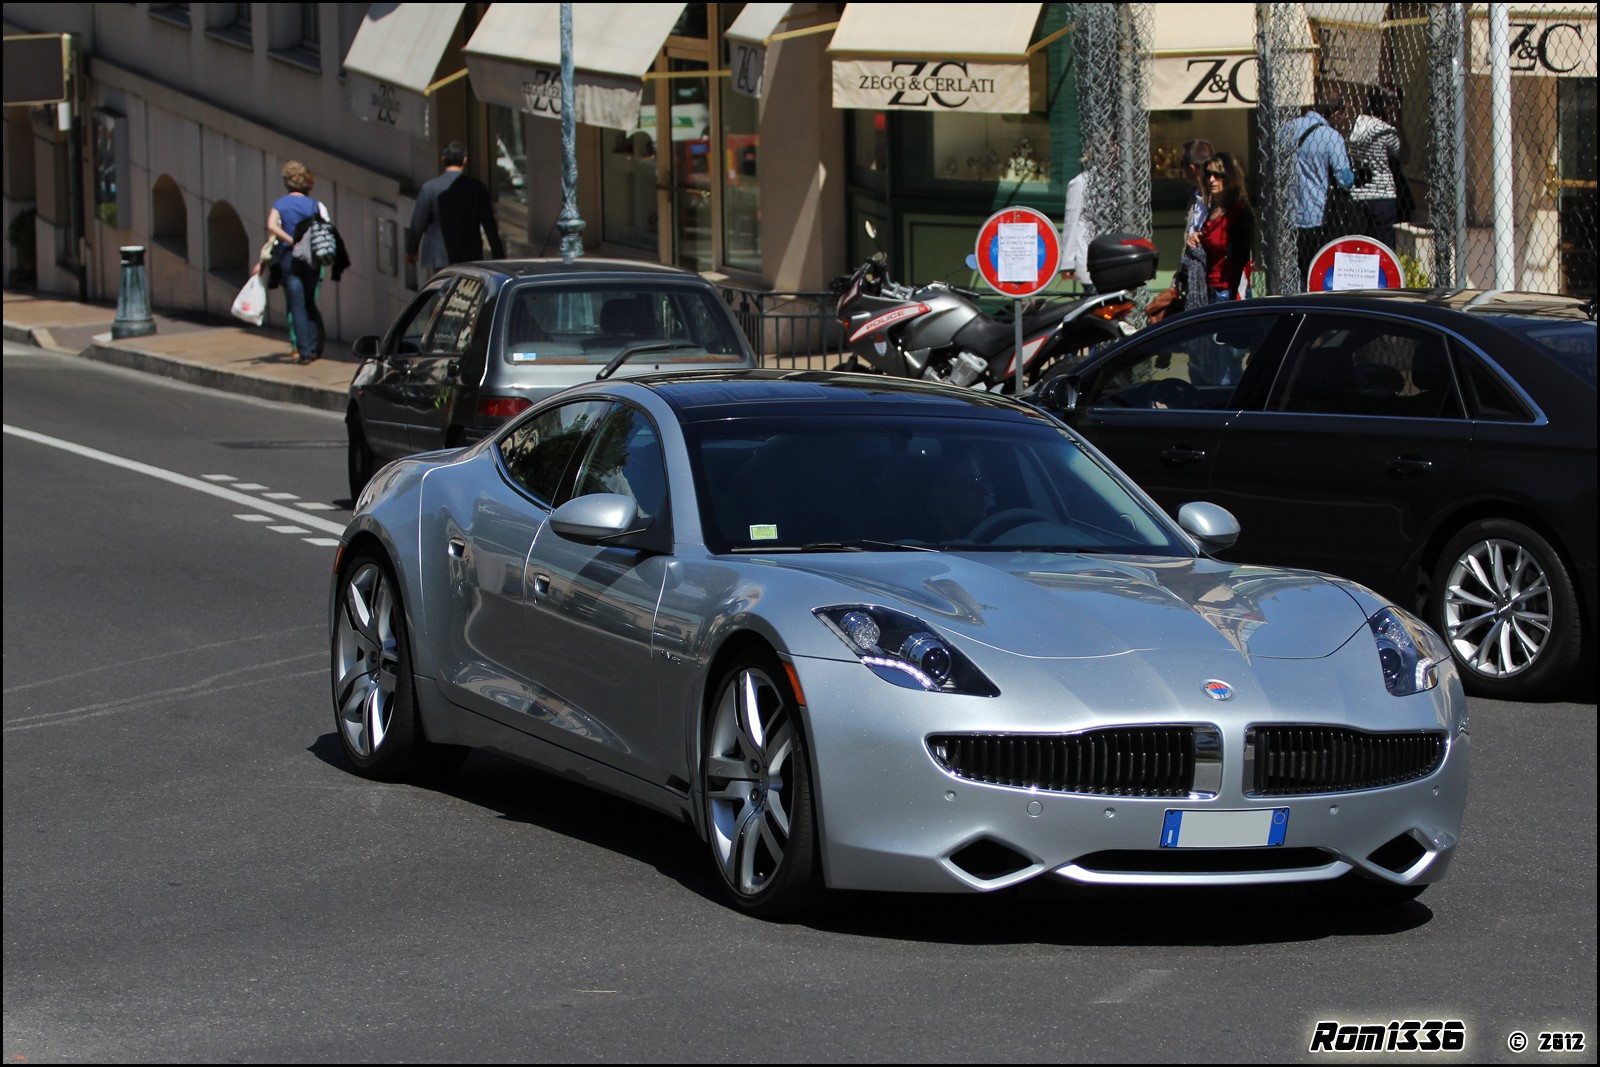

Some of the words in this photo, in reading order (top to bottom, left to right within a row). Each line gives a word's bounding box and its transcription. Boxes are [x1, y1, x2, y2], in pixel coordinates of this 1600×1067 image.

[859, 75, 906, 90] ZEGG
[923, 77, 996, 93] CERLATI
[866, 311, 904, 330] POLICE
